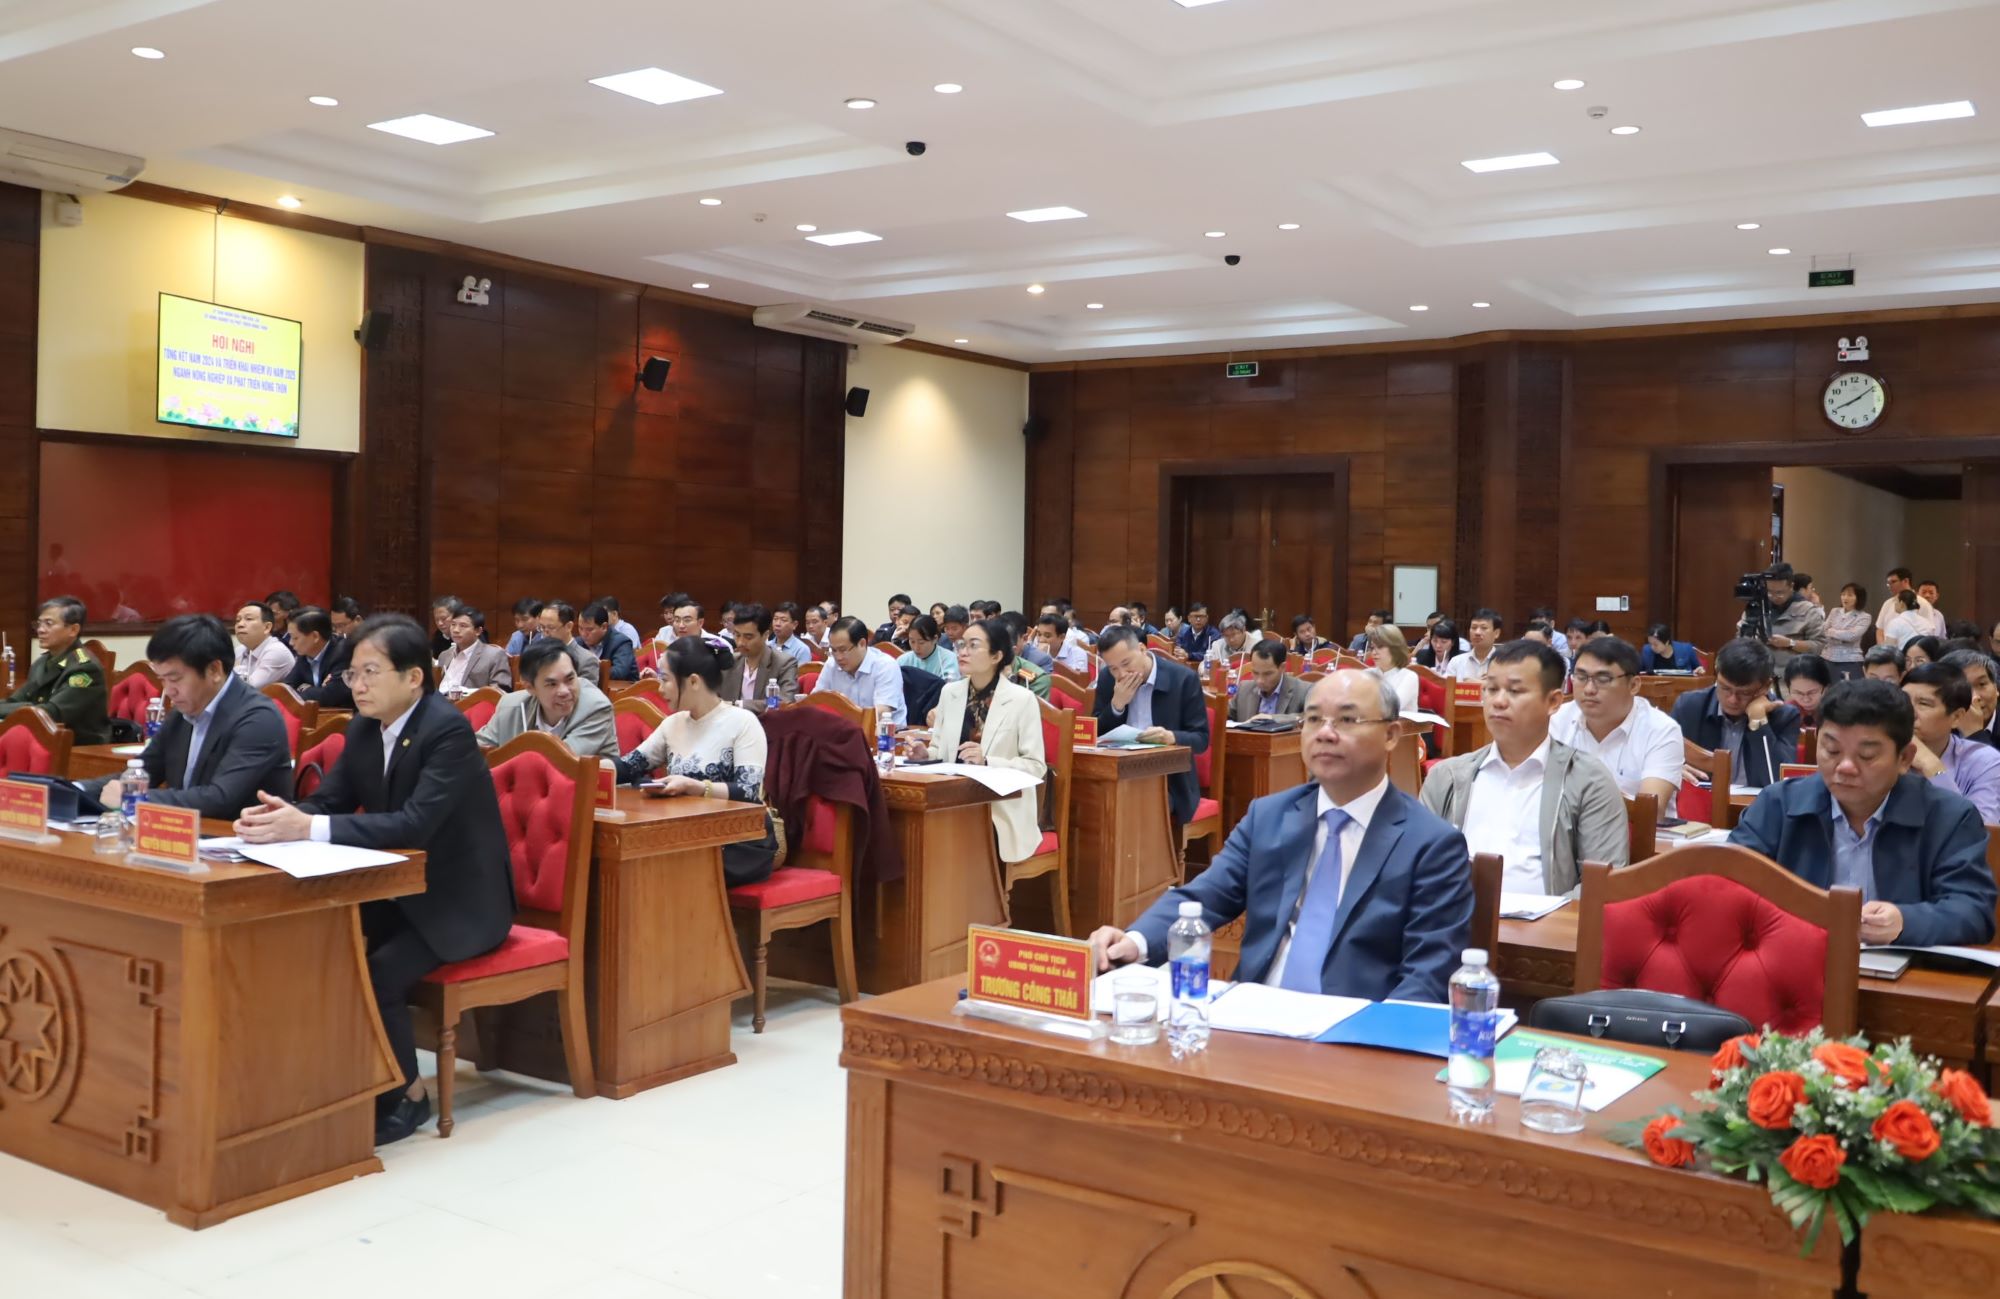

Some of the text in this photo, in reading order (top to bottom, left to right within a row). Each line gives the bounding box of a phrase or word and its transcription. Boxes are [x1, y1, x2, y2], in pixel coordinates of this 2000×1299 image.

[1850, 376, 1859, 384] 12
[980, 975, 1078, 1009] TRƯƠNG CÔNG THÁI
